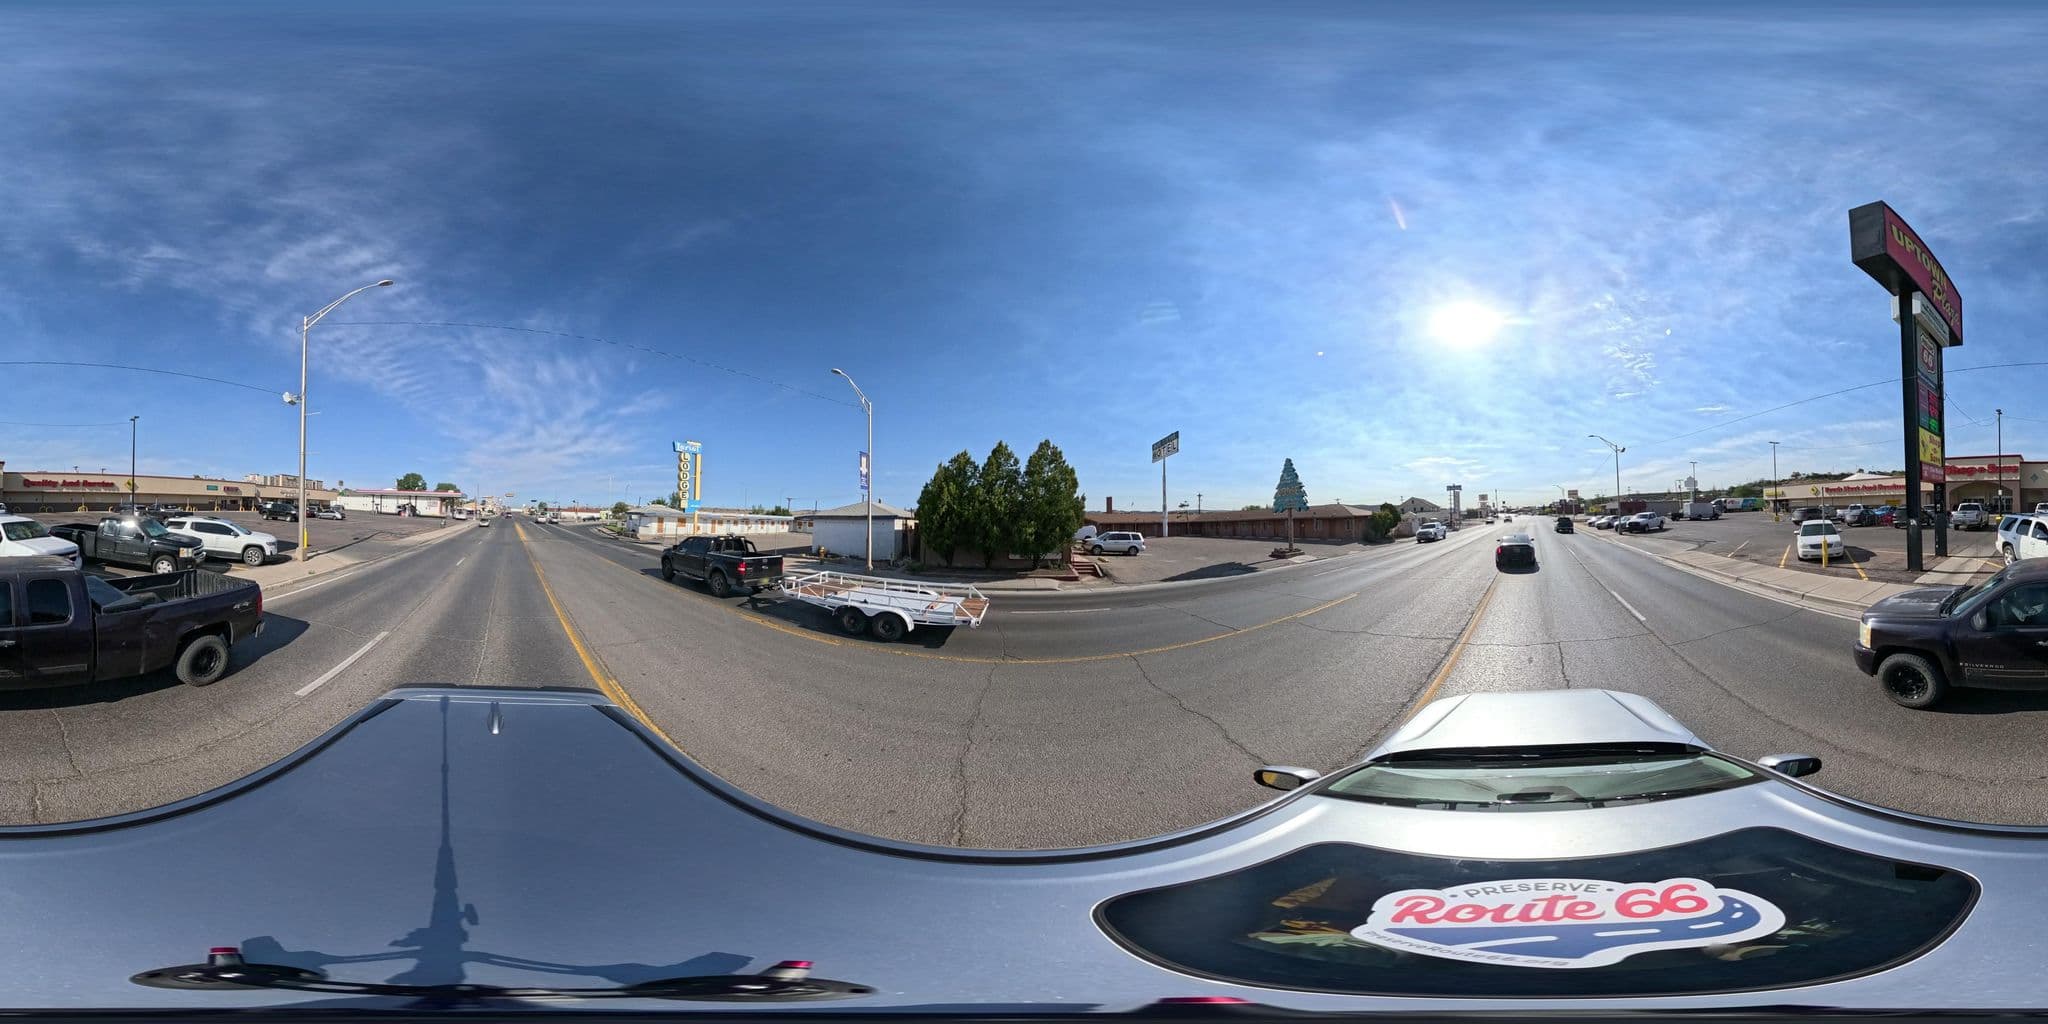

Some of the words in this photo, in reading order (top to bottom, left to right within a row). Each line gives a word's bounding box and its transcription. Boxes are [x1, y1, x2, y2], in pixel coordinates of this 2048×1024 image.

[1890, 223, 1948, 289] UPTOWN
[681, 453, 689, 499] LODGE
[1389, 895, 1606, 924] Route
[1613, 883, 1709, 918] 66
[1463, 882, 1601, 898] PRESERVE
